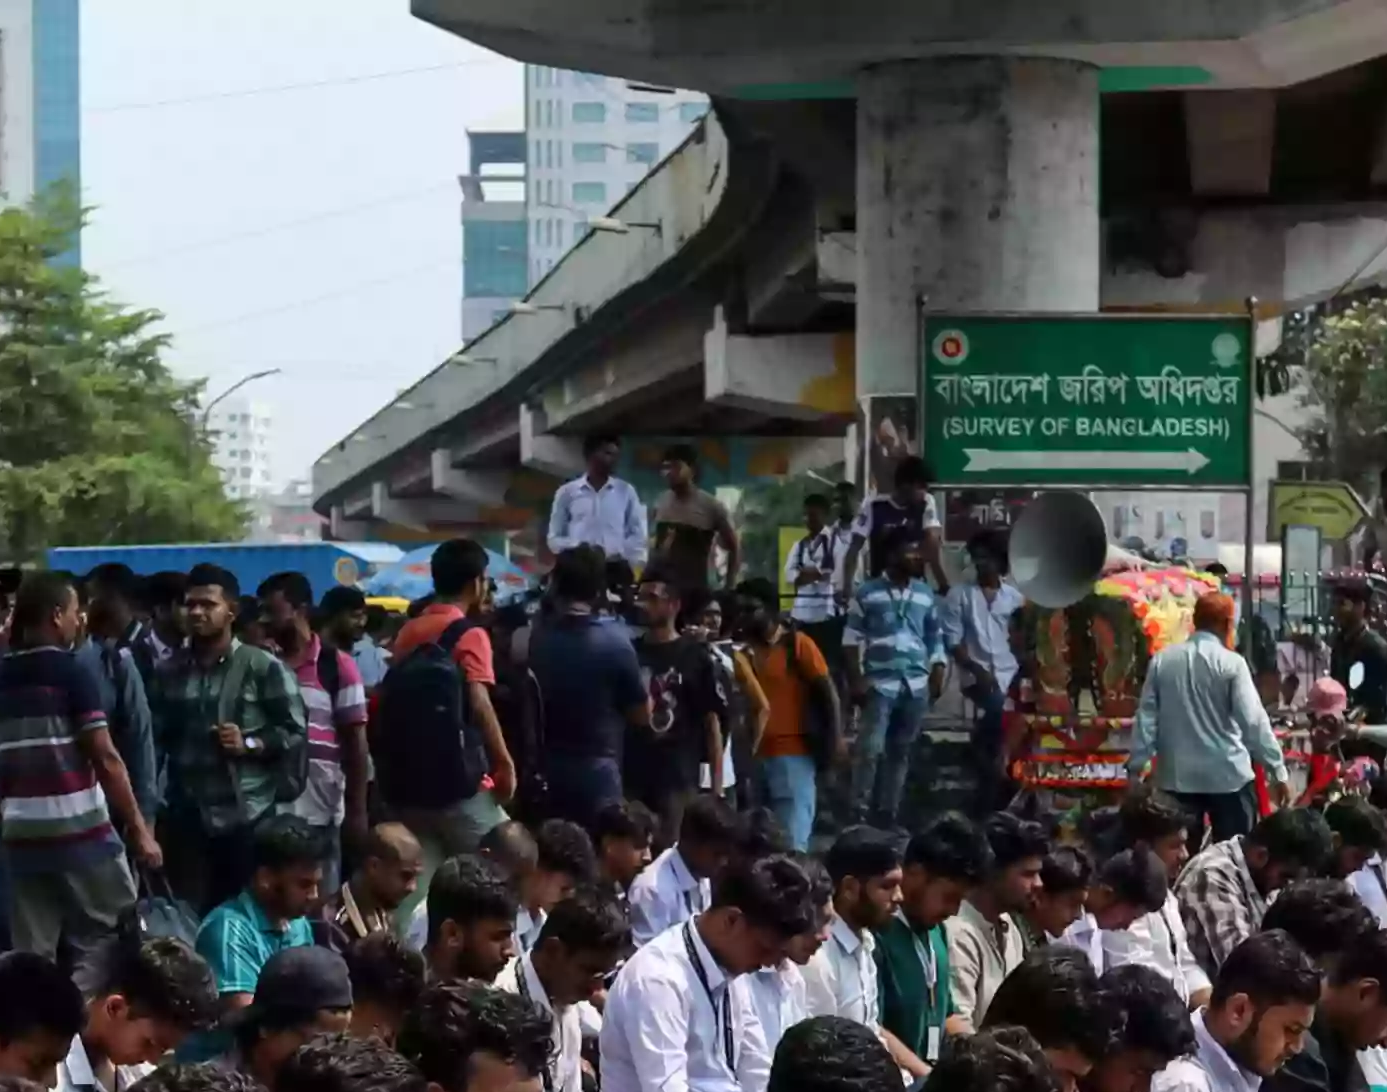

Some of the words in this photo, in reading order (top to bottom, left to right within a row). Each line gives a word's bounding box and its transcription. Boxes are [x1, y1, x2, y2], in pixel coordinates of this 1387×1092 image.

[932, 371, 1051, 408] বাংলাদেশ
[1056, 364, 1130, 405] জরিপ
[1135, 364, 1241, 407] অধিদপ্তর
[942, 416, 1035, 440] (SURVEY
[1040, 416, 1071, 437] OF
[1075, 416, 1231, 442] BANGLADESH)
